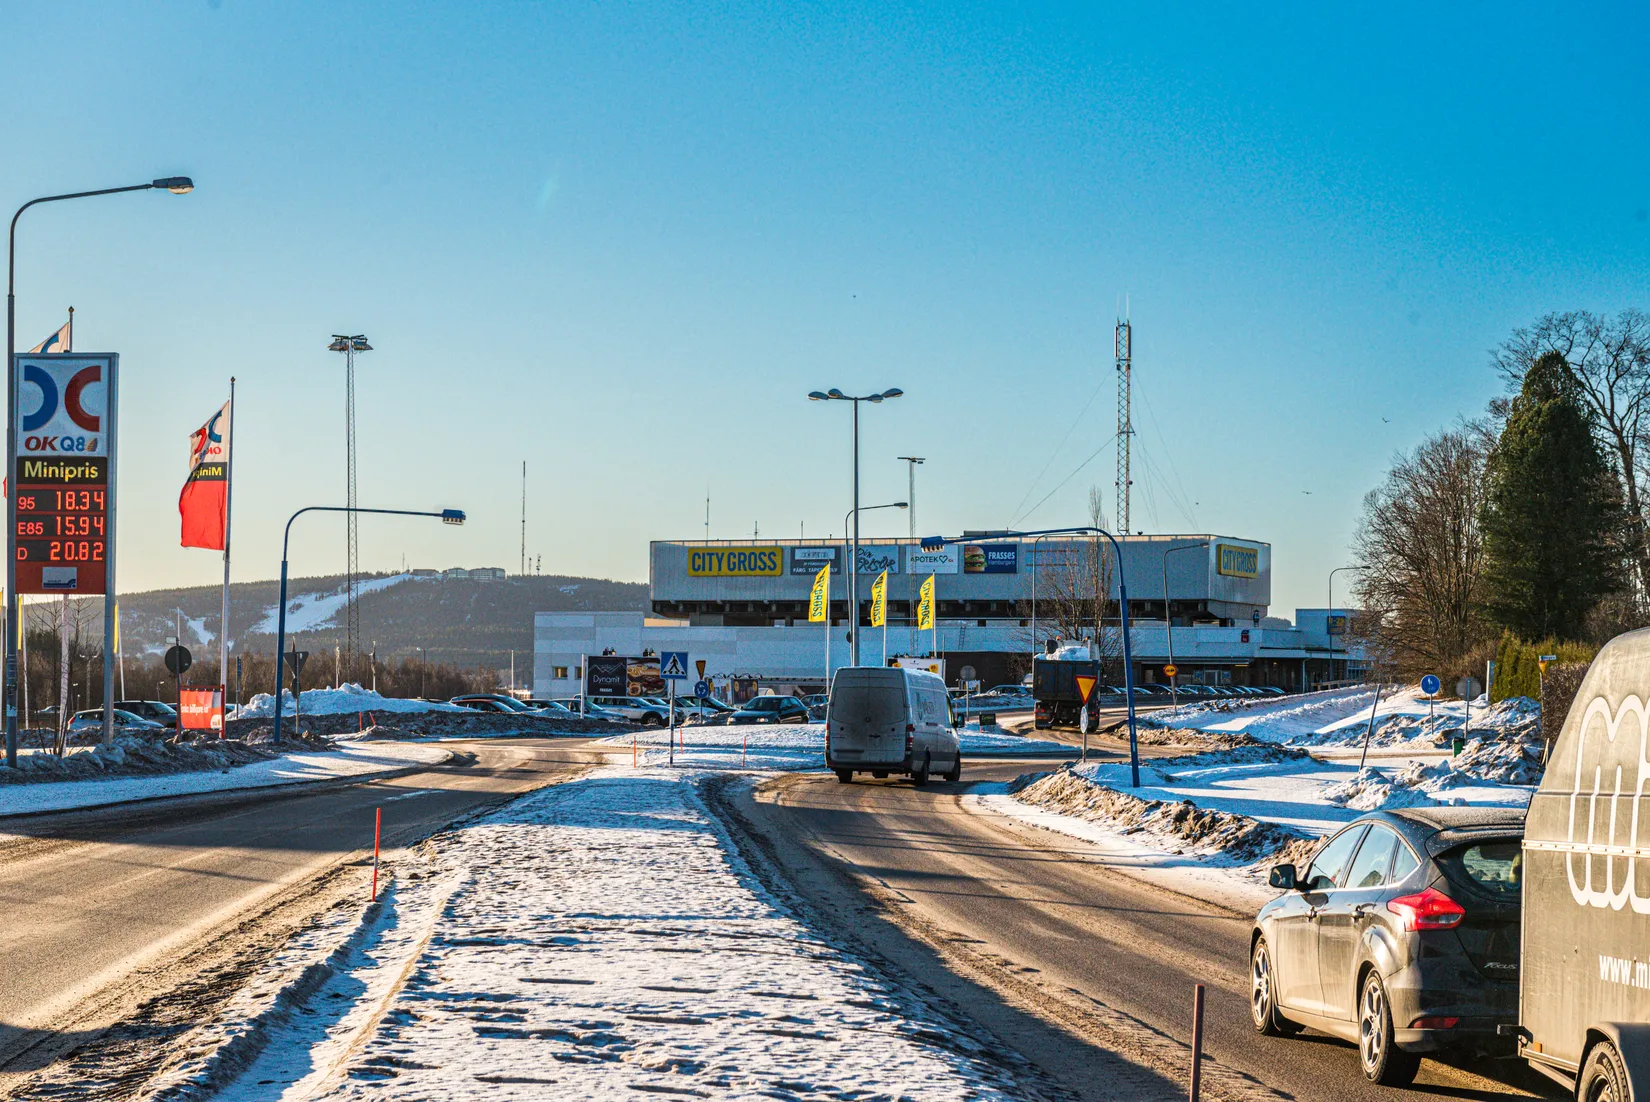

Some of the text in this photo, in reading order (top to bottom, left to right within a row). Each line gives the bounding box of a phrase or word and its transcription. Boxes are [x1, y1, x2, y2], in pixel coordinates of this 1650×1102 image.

[24, 461, 98, 483] Minipris
[18, 491, 104, 510] 95 18.34
[17, 516, 103, 535] E85 15.94
[17, 541, 103, 560] D 20.82
[910, 555, 939, 563] APOTEK
[692, 551, 777, 571] CITY GROSS
[593, 675, 620, 684] Dynamit
